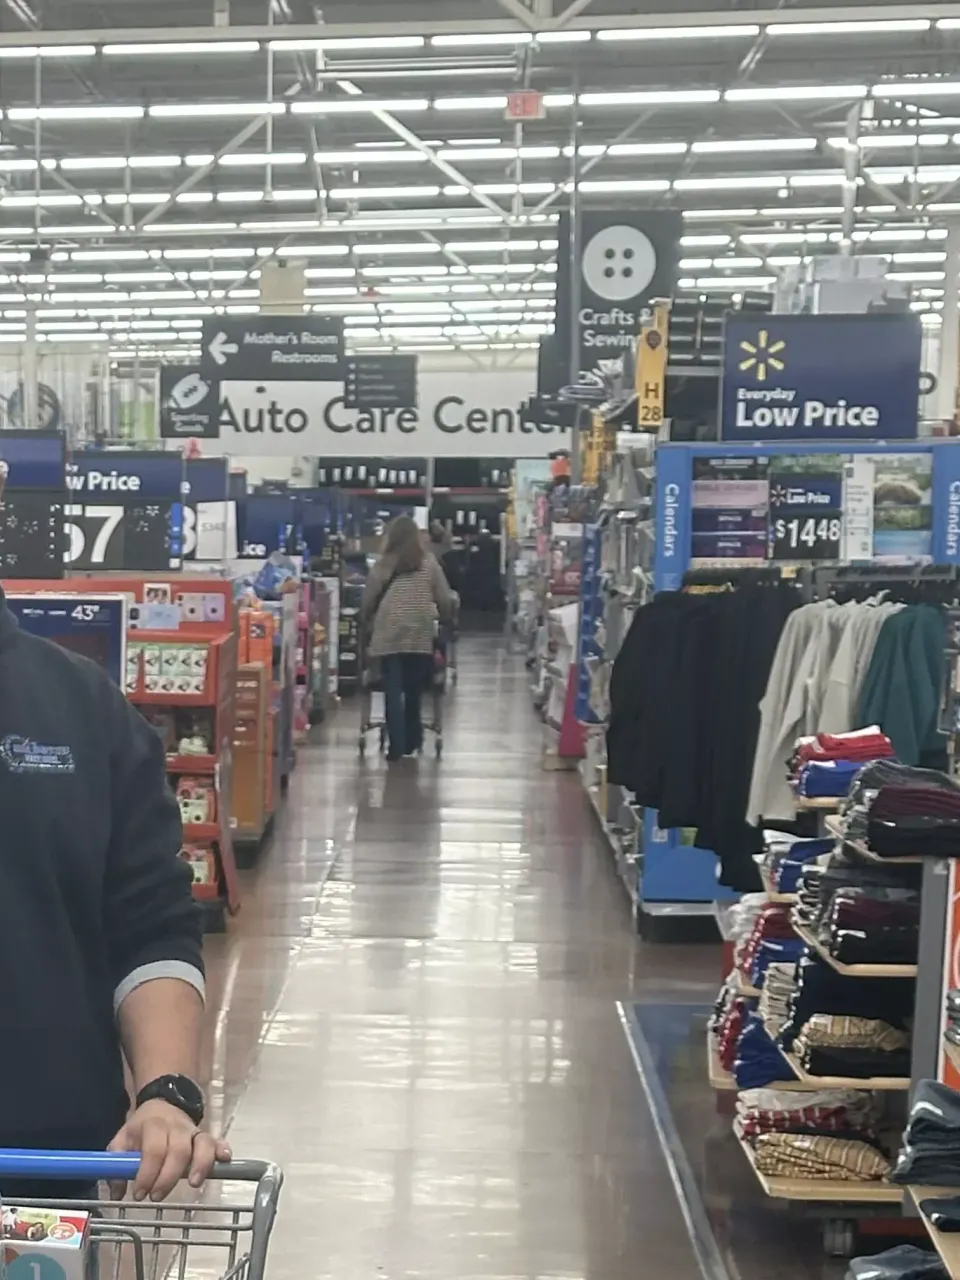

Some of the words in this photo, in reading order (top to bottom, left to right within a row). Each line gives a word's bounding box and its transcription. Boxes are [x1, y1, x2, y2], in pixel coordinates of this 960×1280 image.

[578, 309, 634, 325] Crafts
[244, 332, 298, 344] Mother's
[301, 332, 338, 344] Room
[272, 350, 338, 363] Restrooms
[644, 382, 660, 400] H
[737, 388, 796, 402] Everyday
[218, 397, 309, 433] Auto
[323, 396, 419, 433] Care
[641, 405, 661, 422] 28
[736, 402, 800, 428] Low
[804, 401, 879, 427] Price
[88, 472, 141, 490] Price
[807, 491, 831, 504] Price
[663, 482, 680, 558] Calendars
[945, 480, 960, 556] Calendars
[243, 540, 267, 556] ice
[71, 604, 100, 620] 43"
